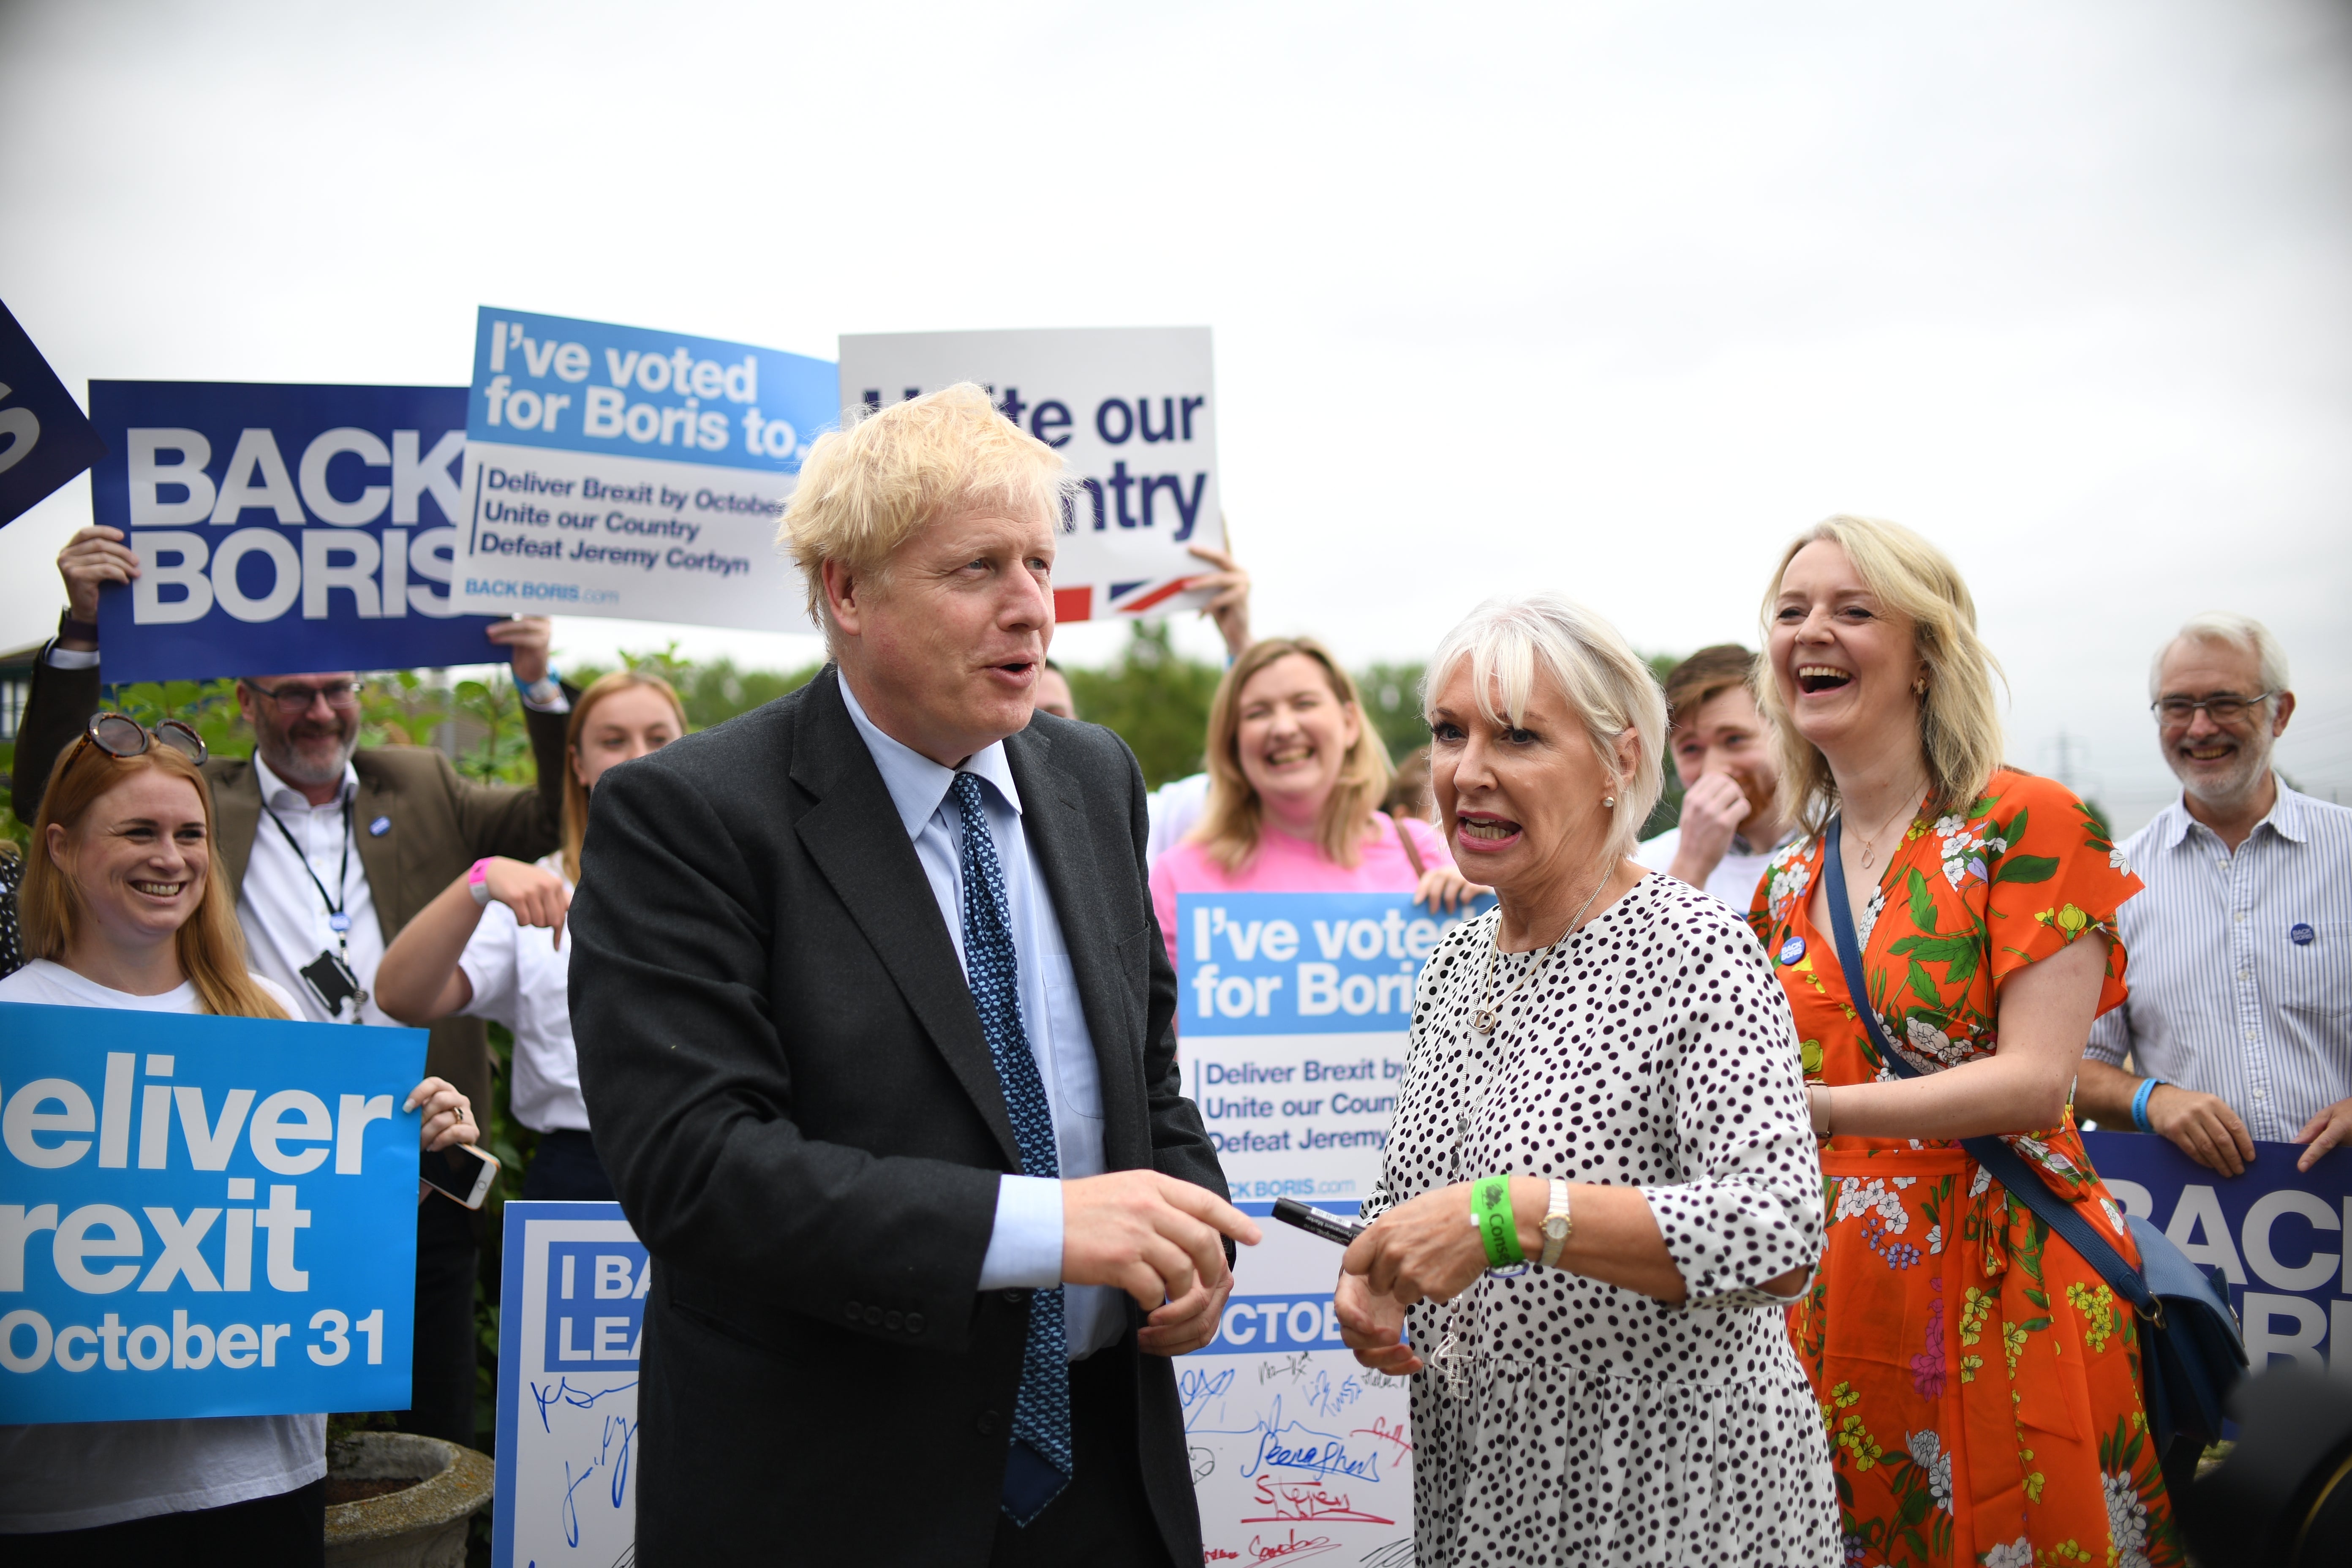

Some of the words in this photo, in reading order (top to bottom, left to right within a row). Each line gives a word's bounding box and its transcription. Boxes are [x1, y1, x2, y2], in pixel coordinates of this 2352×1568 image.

[605, 347, 757, 403] voted
[484, 375, 571, 432] for
[583, 385, 730, 451] Boris
[1097, 395, 1204, 445] our
[127, 426, 468, 527] BACK
[489, 469, 576, 496] Deliver
[583, 478, 652, 504] Brexit
[660, 486, 688, 512] by
[486, 501, 549, 526] Unite
[558, 512, 599, 529] our
[606, 512, 700, 544] Country
[131, 527, 466, 625] BORIS
[481, 532, 562, 558] Defeat
[570, 540, 659, 570] Jeremy
[666, 548, 749, 577] Corbyn
[1781, 940, 1802, 954] BACK
[1781, 947, 1802, 961] BORIS
[1192, 964, 1282, 1018] for
[1297, 961, 1418, 1016] Bori
[1206, 1062, 1296, 1084] Deliver
[1304, 1058, 1374, 1081] Brexit
[0, 1051, 393, 1176] eliver
[1207, 1097, 1273, 1119] Unite
[1282, 1100, 1324, 1116] our
[1332, 1092, 1394, 1114] Coun
[1209, 1130, 1290, 1152] Defeat
[1299, 1128, 1389, 1150] Jeremy
[0, 1177, 311, 1294] rexit
[1304, 1215, 1324, 1226] Marker
[1324, 1222, 1353, 1237] Permanent
[561, 1255, 575, 1299] I
[0, 1309, 290, 1373] October
[307, 1308, 384, 1366] 31
